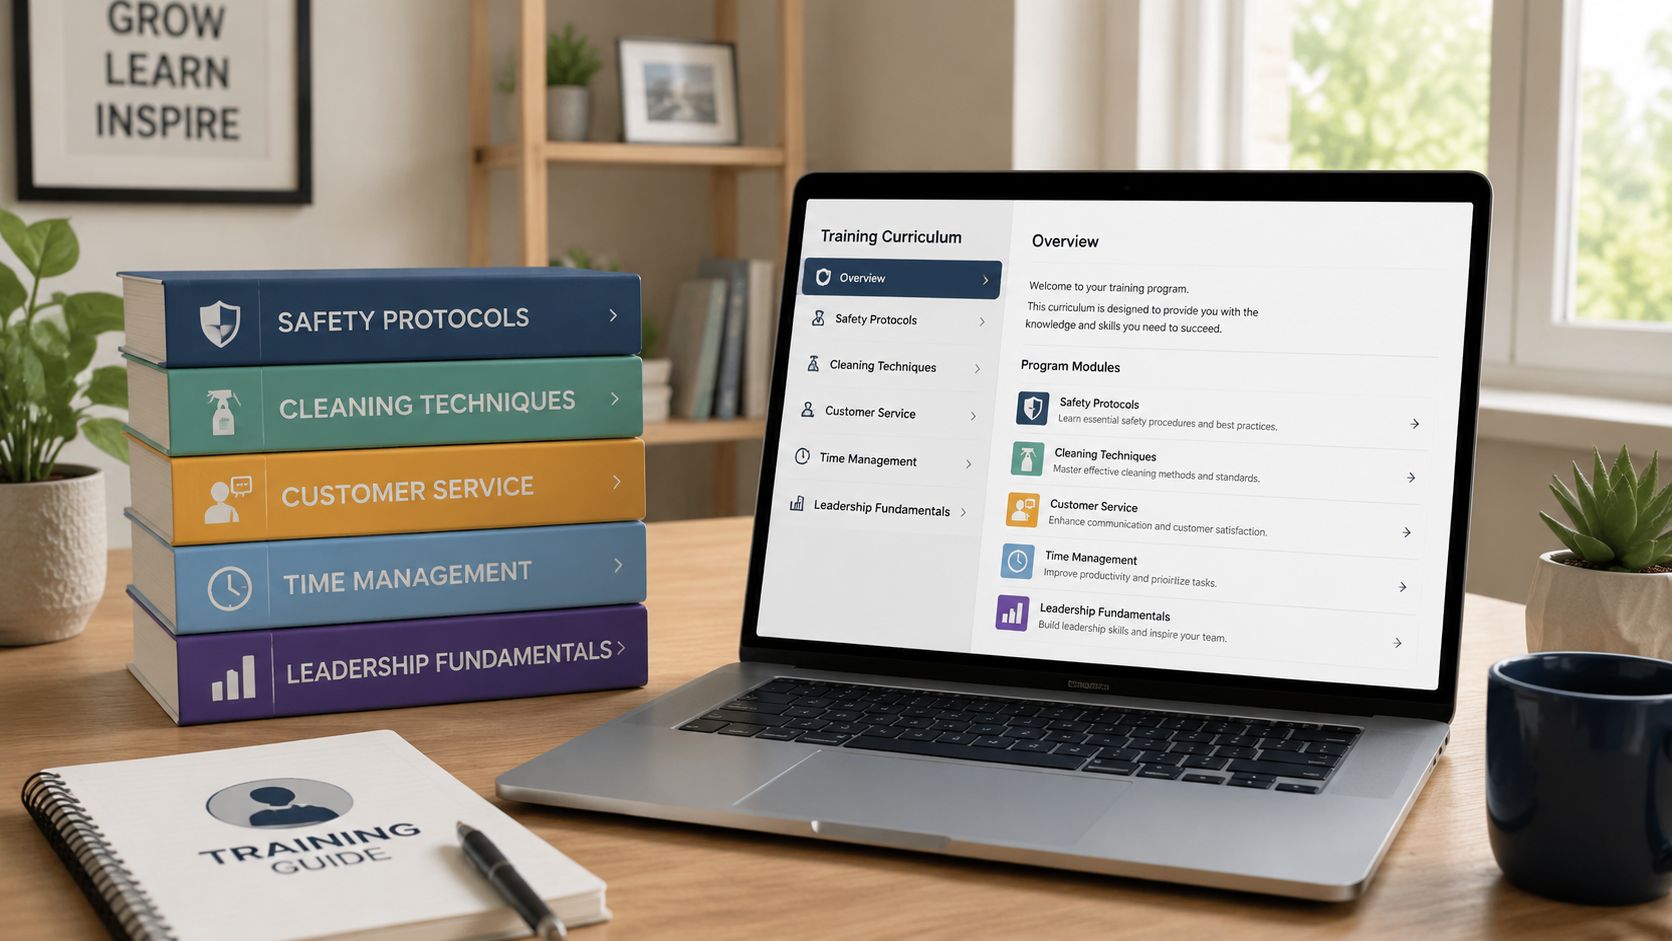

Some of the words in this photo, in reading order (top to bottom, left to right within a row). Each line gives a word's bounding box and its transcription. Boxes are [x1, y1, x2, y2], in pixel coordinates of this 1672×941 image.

[107, 0, 225, 40] GROW
[105, 52, 229, 89] LEARN
[96, 102, 241, 141] INSPIRE
[820, 228, 878, 247] Training
[881, 229, 962, 244] Curriculum
[1032, 233, 1100, 248] Overview
[839, 272, 886, 283] Overview
[1029, 280, 1072, 291] Welcome
[1074, 283, 1084, 292] to
[1085, 283, 1107, 294] your
[1109, 283, 1145, 295] training
[1147, 285, 1188, 296] program.
[1027, 301, 1046, 312] This
[1047, 302, 1095, 313] curriculum
[1097, 304, 1105, 313] is
[1106, 303, 1150, 316] designed
[1151, 305, 1161, 315] to
[1163, 305, 1199, 317] provide
[1200, 308, 1218, 318] you
[1220, 307, 1241, 317] with
[1243, 307, 1259, 317] the
[278, 310, 376, 333] SAFETY
[383, 307, 530, 331] PROTOCOLS
[835, 313, 868, 327] Safety
[869, 314, 918, 326] Protocols
[1025, 319, 1077, 331] knowledge
[1078, 320, 1096, 330] and
[1098, 320, 1121, 331] skills
[1122, 323, 1140, 333] you
[1142, 322, 1167, 333] need
[1168, 323, 1179, 333] to
[1180, 323, 1223, 334] succeed.
[829, 359, 875, 373] Cleaning
[877, 361, 937, 374] Techniques
[1021, 359, 1069, 373] Program
[1071, 361, 1121, 373] Modules
[279, 395, 413, 421] CLEANING
[419, 389, 576, 415] TECHNIQUES
[1059, 396, 1091, 409] Safety
[1093, 398, 1140, 410] Protocols
[825, 405, 876, 418] Customer
[877, 407, 916, 420] Service
[1058, 414, 1082, 423] Learn
[1083, 415, 1119, 425] essential
[1121, 416, 1147, 427] safety
[1148, 418, 1197, 428] procedures
[1197, 419, 1215, 429] and
[1215, 420, 1235, 430] best
[1236, 422, 1277, 432] practices.
[819, 452, 845, 464] Time
[847, 453, 917, 468] Management
[1054, 447, 1098, 461] Cleaning
[1100, 449, 1157, 463] Techniques
[1053, 464, 1082, 474] Master
[1083, 465, 1120, 476] effective
[1121, 467, 1157, 480] cleaning
[1158, 470, 1196, 480] methods
[1197, 471, 1214, 481] and
[1215, 473, 1261, 483] standards.
[281, 481, 426, 508] CUSTOMER
[433, 475, 534, 500] SERVICE
[814, 499, 873, 515] Leadership
[874, 502, 951, 517] Fundamentals
[1050, 498, 1099, 511] Customer
[1100, 501, 1139, 513] Service
[1048, 515, 1086, 526] Enhance
[1087, 518, 1153, 529] communication
[1154, 522, 1172, 531] and
[1172, 524, 1214, 534] customer
[1215, 525, 1267, 537] satisfaction.
[1045, 550, 1070, 562] Time
[1071, 552, 1138, 566] Management
[283, 572, 346, 595] TIME
[353, 560, 532, 591] MANAGEMENT
[1043, 567, 1078, 578] Improve
[1079, 570, 1131, 583] productivity
[1132, 574, 1149, 583] and
[1192, 577, 1217, 588] tasks.
[1040, 603, 1096, 618] Leadership
[1098, 606, 1171, 622] Fundamentals
[1038, 619, 1060, 630] Build
[1061, 621, 1106, 635] leadership
[1108, 625, 1129, 636] skills
[1130, 627, 1148, 637] and
[1149, 630, 1178, 640] inspire
[1179, 632, 1200, 641] your
[1202, 633, 1227, 643] team.
[287, 654, 430, 685] LEADERSHIP
[435, 639, 613, 673] FUNDAMENTALS
[198, 822, 421, 865] TRAINING
[270, 846, 391, 874] GUIDE
